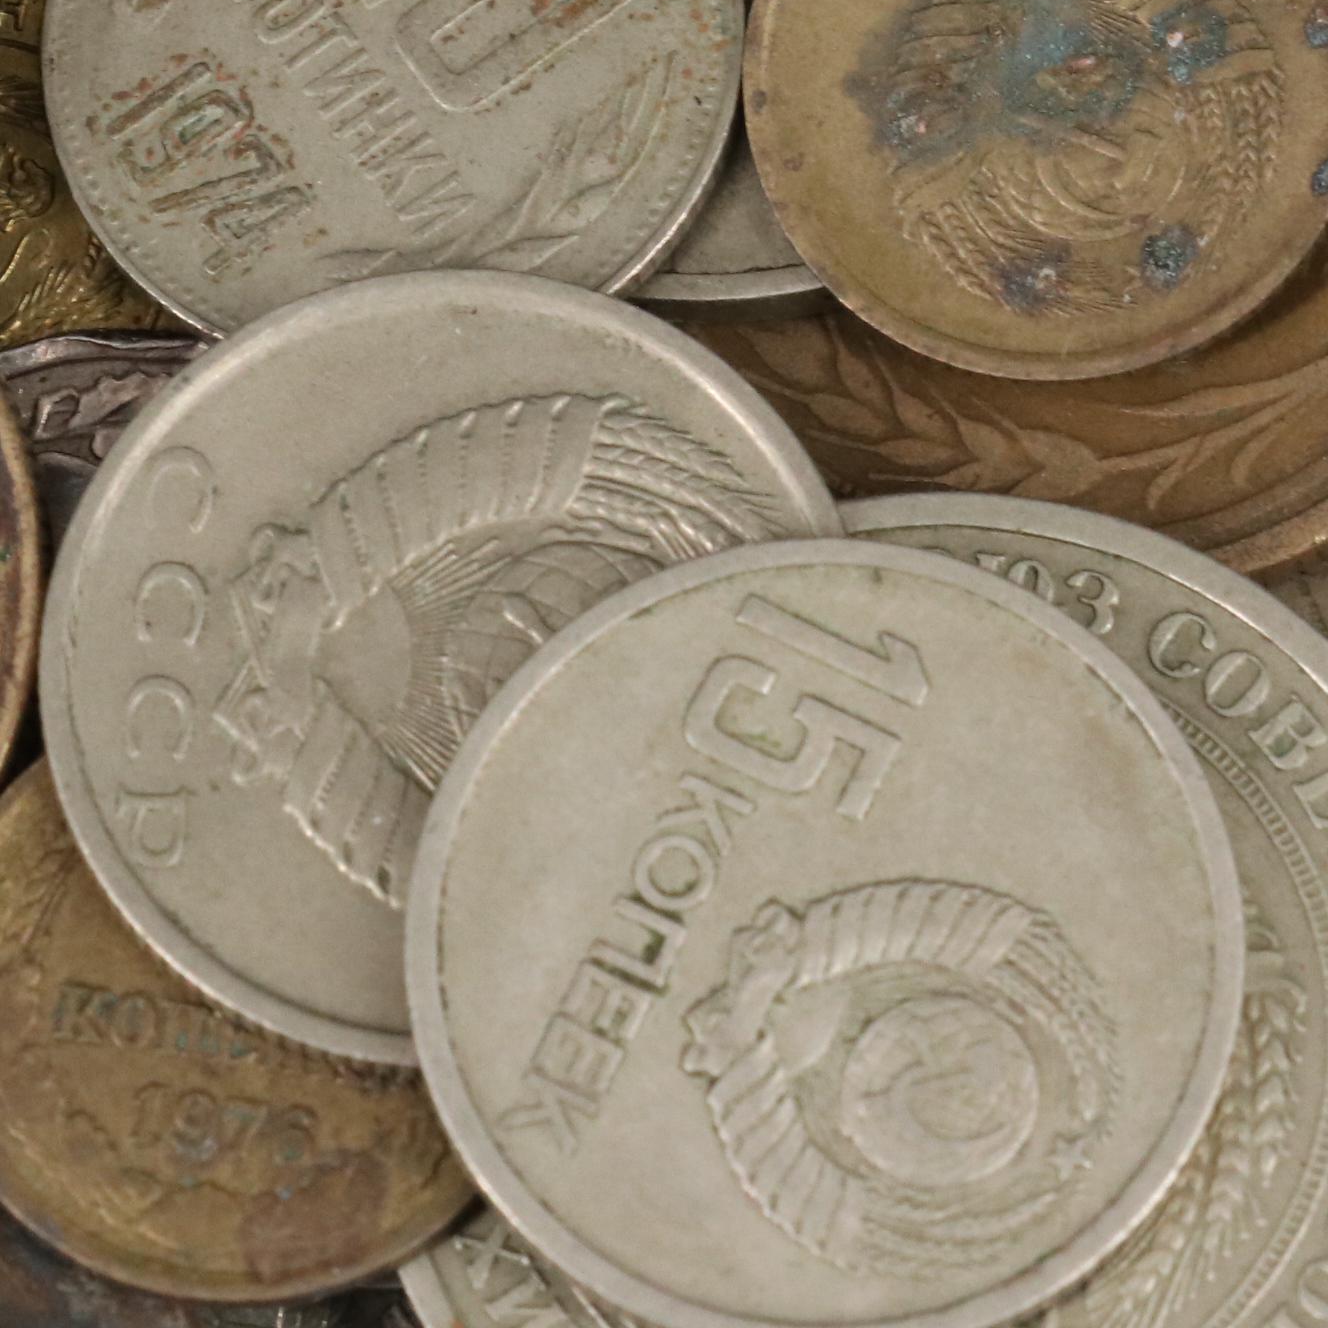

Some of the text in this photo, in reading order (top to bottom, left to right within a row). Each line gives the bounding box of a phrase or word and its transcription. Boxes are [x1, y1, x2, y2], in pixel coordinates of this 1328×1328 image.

[103, 60, 312, 277] 1974
[111, 443, 214, 868] СССР
[684, 590, 932, 822] 15
[496, 770, 757, 1157] КОПЕЕК
